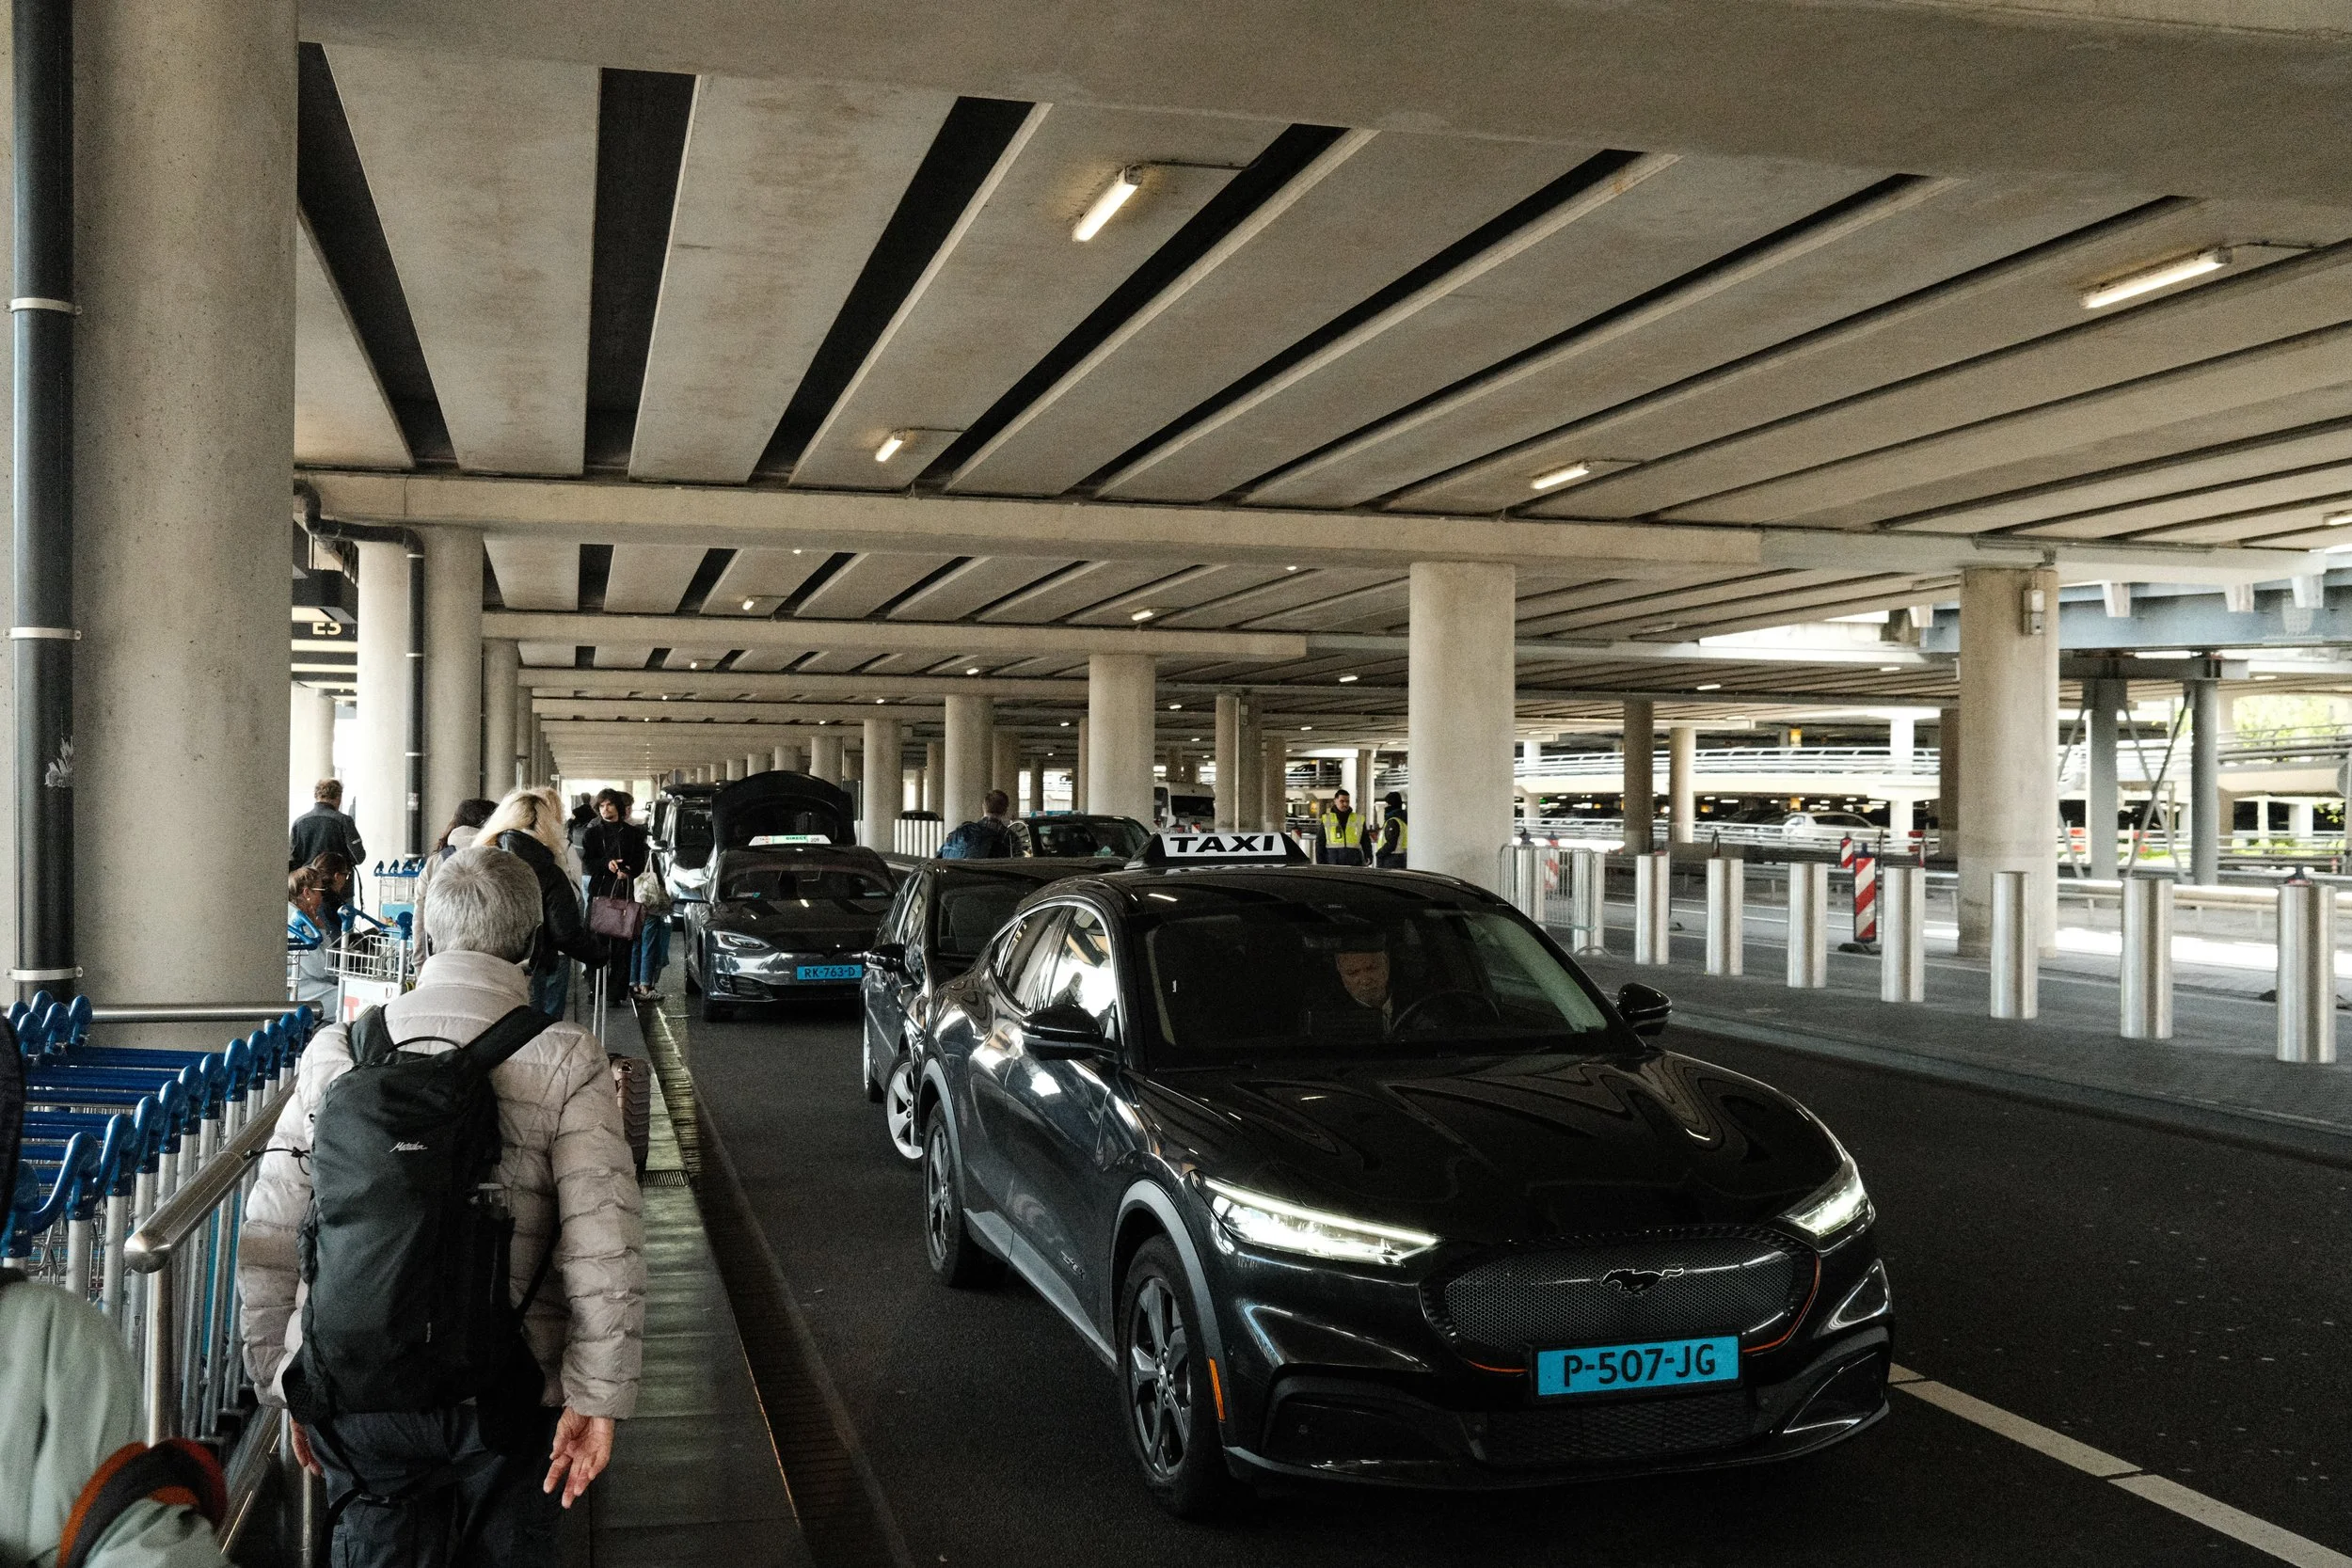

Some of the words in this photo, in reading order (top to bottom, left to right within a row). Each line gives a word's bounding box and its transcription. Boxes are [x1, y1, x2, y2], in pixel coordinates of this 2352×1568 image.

[1169, 835, 1274, 853] TAXI
[804, 966, 855, 978] RK-763-D
[1564, 1343, 1716, 1387] P-507-JG
